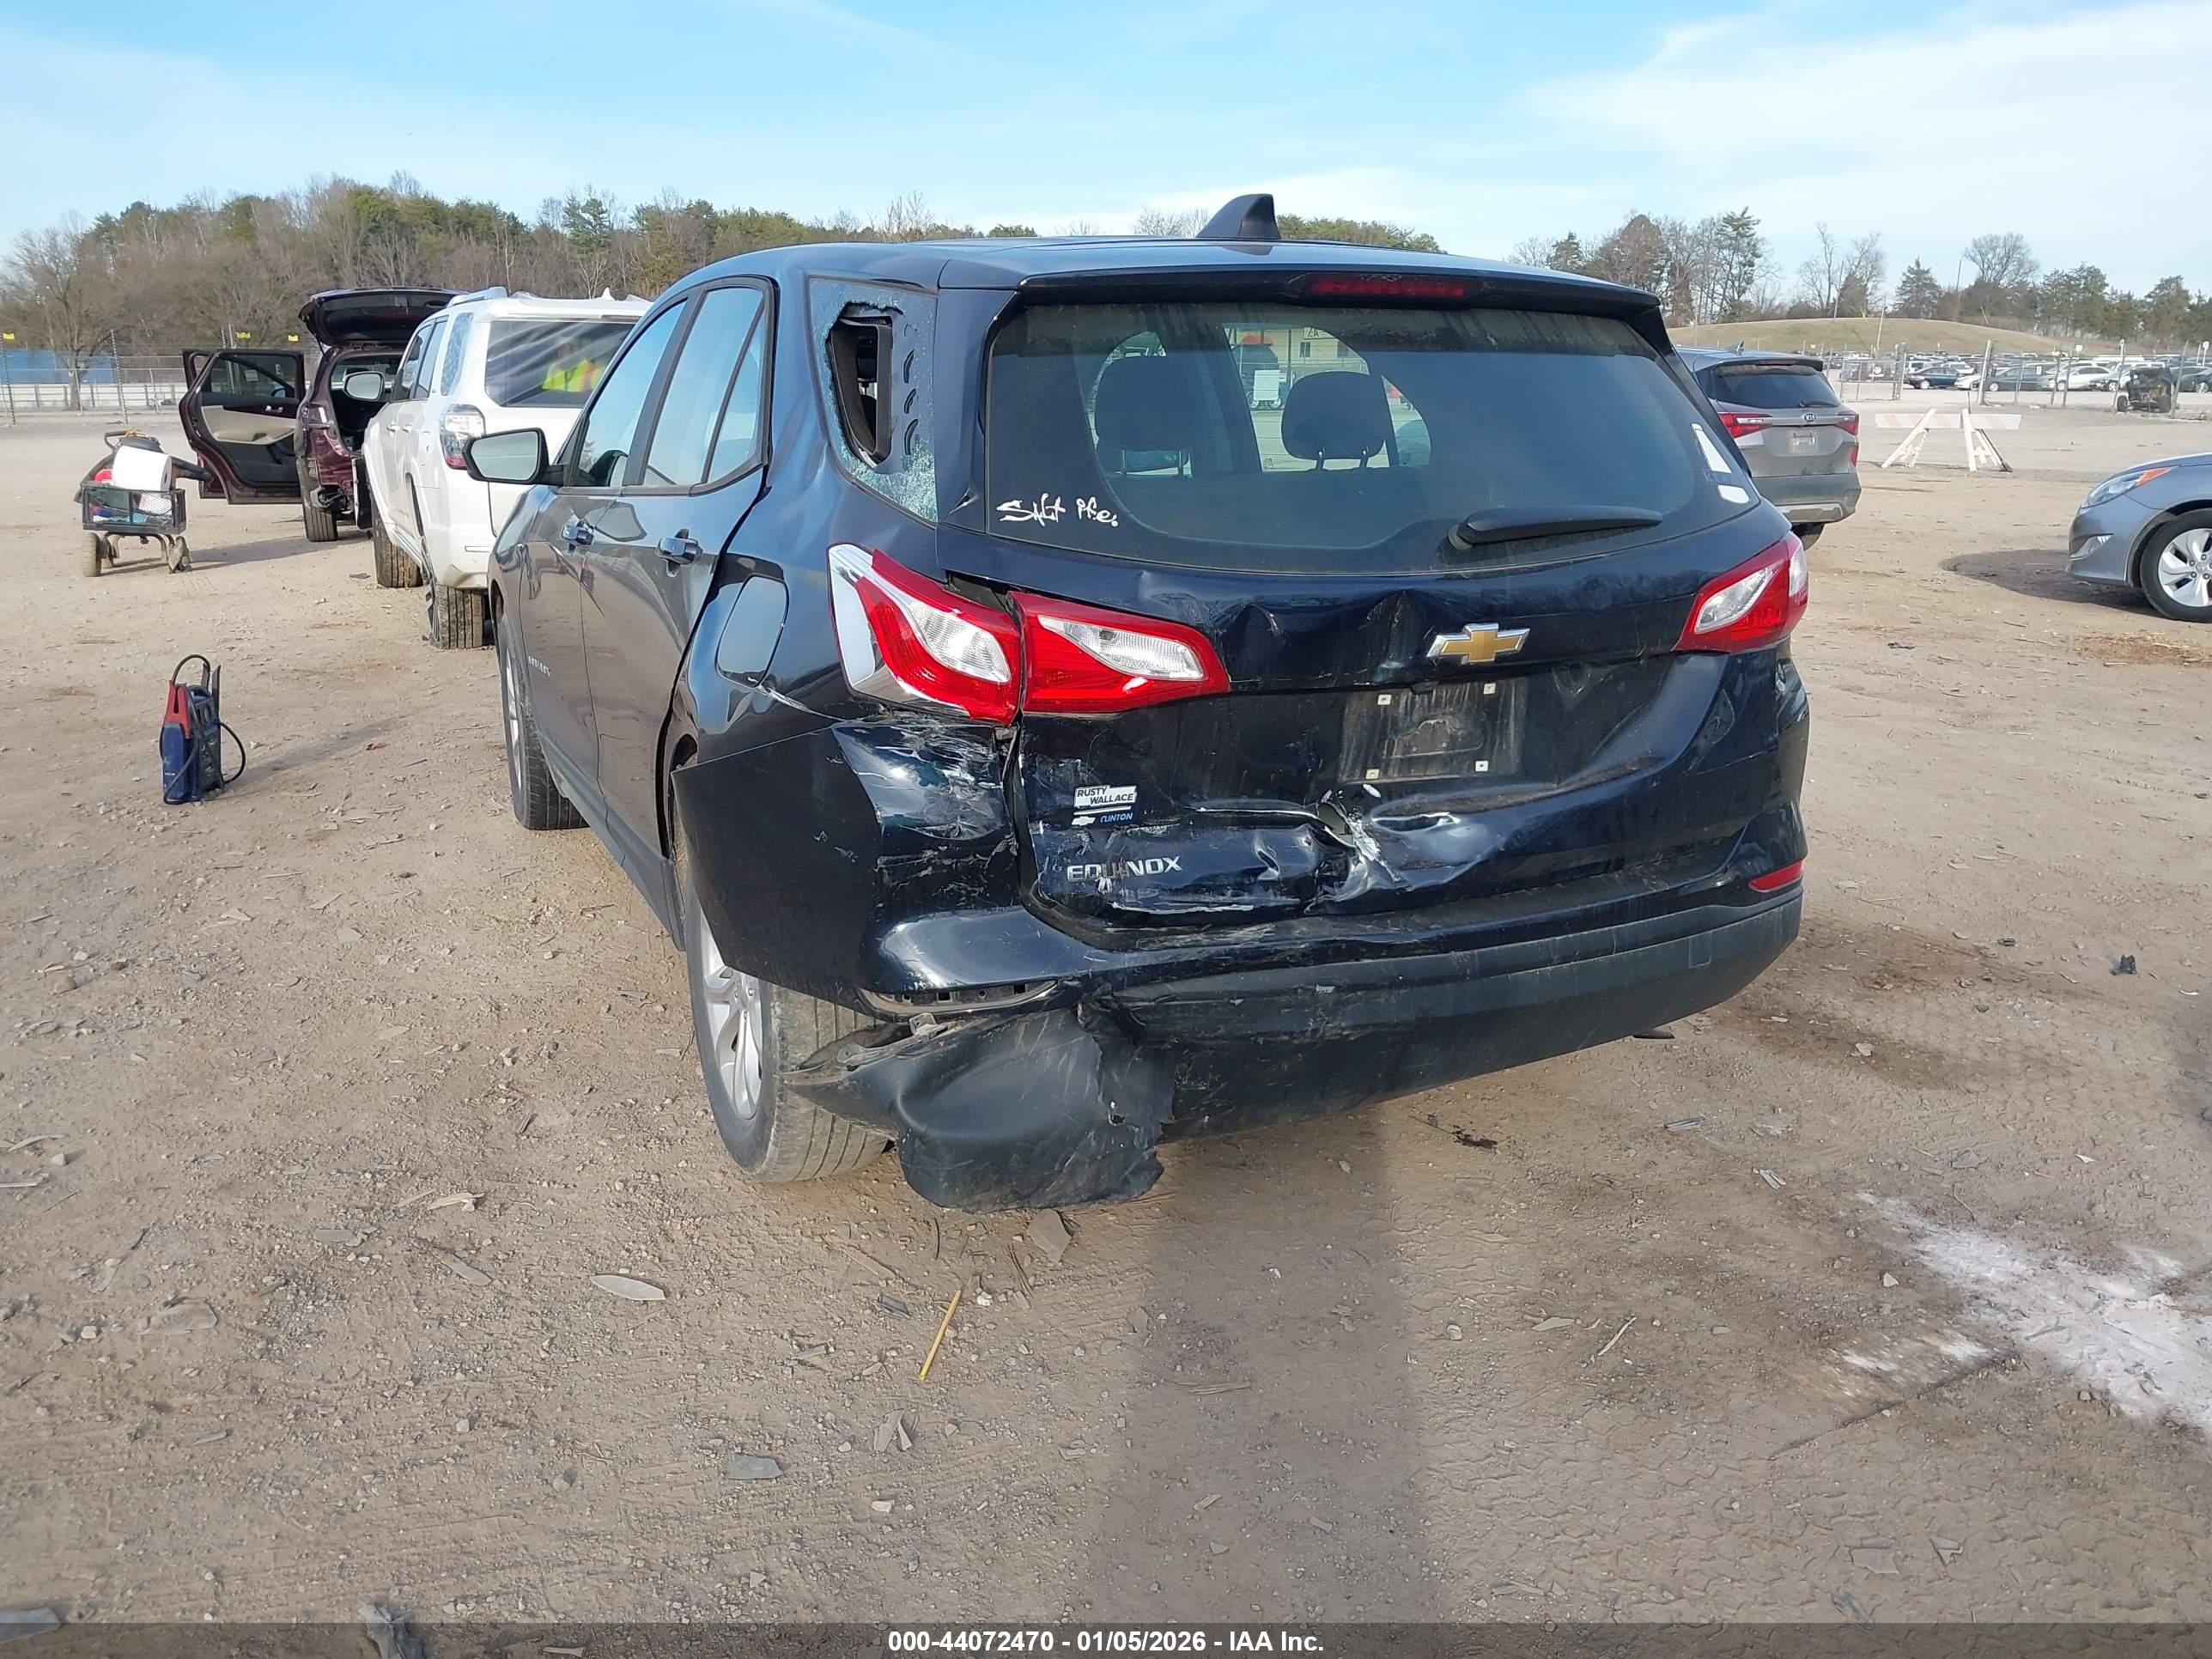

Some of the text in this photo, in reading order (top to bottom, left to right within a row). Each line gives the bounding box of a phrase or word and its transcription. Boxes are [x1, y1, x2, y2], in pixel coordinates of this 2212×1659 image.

[1077, 787, 1108, 798] RUSTY
[1090, 793, 1134, 805] WALLACE
[1100, 812, 1133, 823] CLINTON
